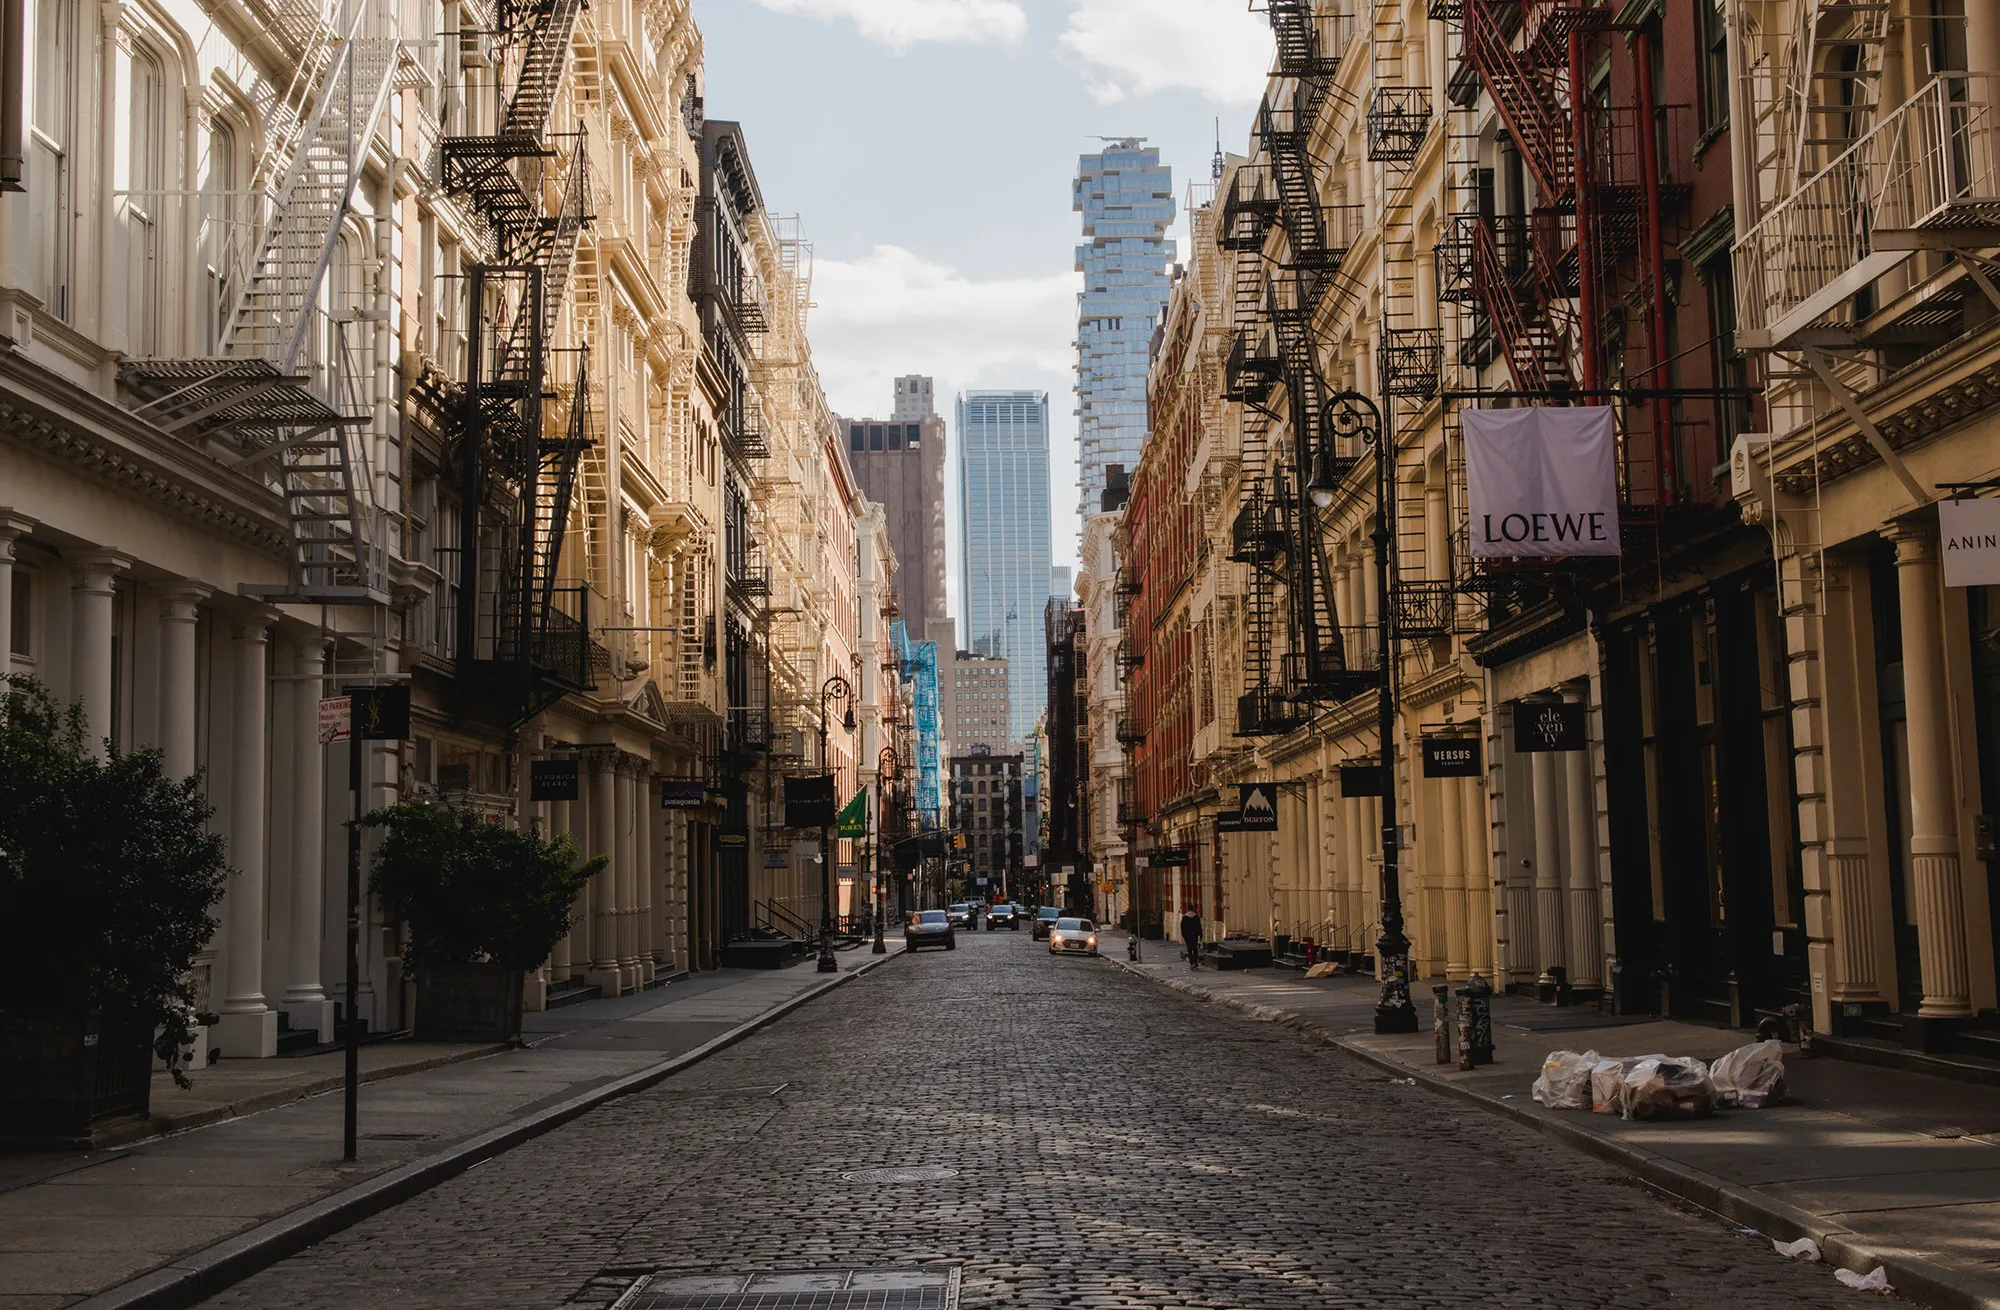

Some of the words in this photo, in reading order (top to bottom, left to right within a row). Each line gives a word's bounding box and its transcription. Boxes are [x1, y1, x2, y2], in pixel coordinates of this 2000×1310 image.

[1483, 512, 1607, 542] LOEWE
[1947, 534, 1997, 550] ANIN
[320, 702, 329, 712] NO
[1433, 750, 1471, 761] VERSUS
[664, 798, 700, 806] patagonia
